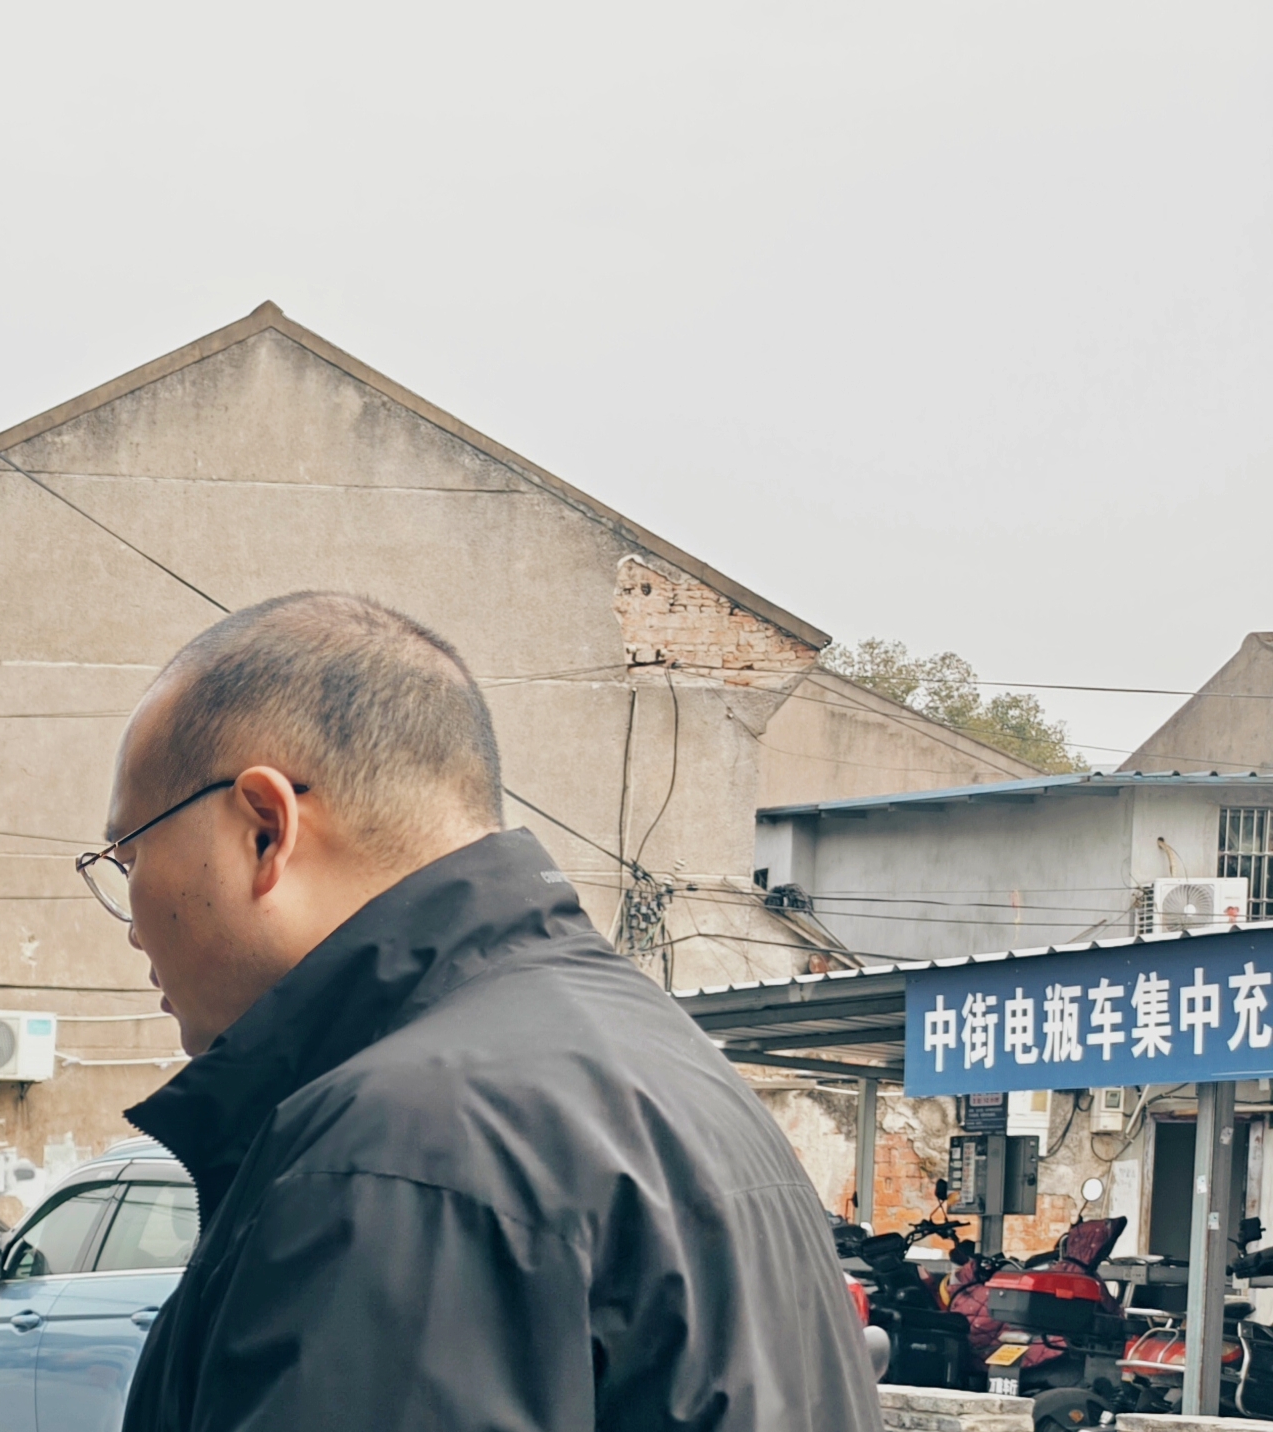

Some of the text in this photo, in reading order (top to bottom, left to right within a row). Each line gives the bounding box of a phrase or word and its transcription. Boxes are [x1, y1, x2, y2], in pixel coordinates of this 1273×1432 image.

[924, 961, 1272, 1072] 中街电瓶车集中充
